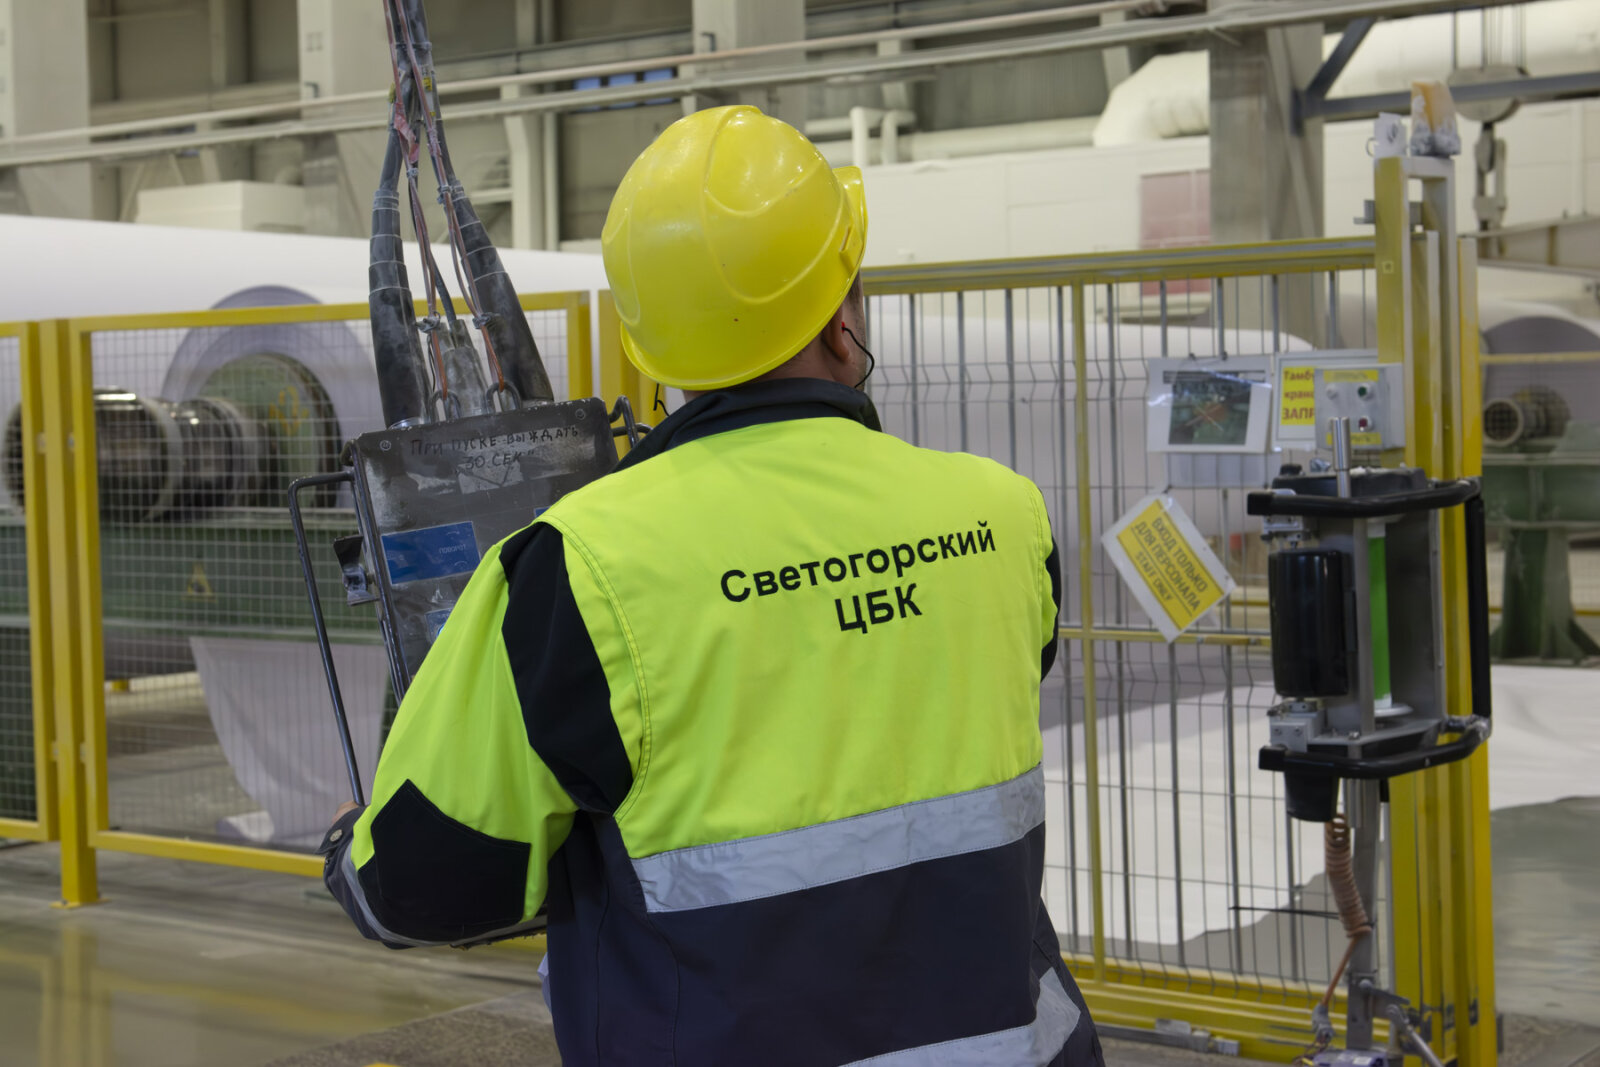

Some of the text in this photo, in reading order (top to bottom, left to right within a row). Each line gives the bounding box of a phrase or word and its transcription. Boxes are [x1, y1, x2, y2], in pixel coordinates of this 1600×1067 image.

[1284, 370, 1314, 381] Тамб
[720, 520, 996, 603] Светогорский
[1134, 521, 1201, 611] ДЛЯ ПЕРСОНАЛА
[1152, 517, 1208, 592] ВХОД ТОЛЬКО
[834, 583, 922, 634] ЦБК
